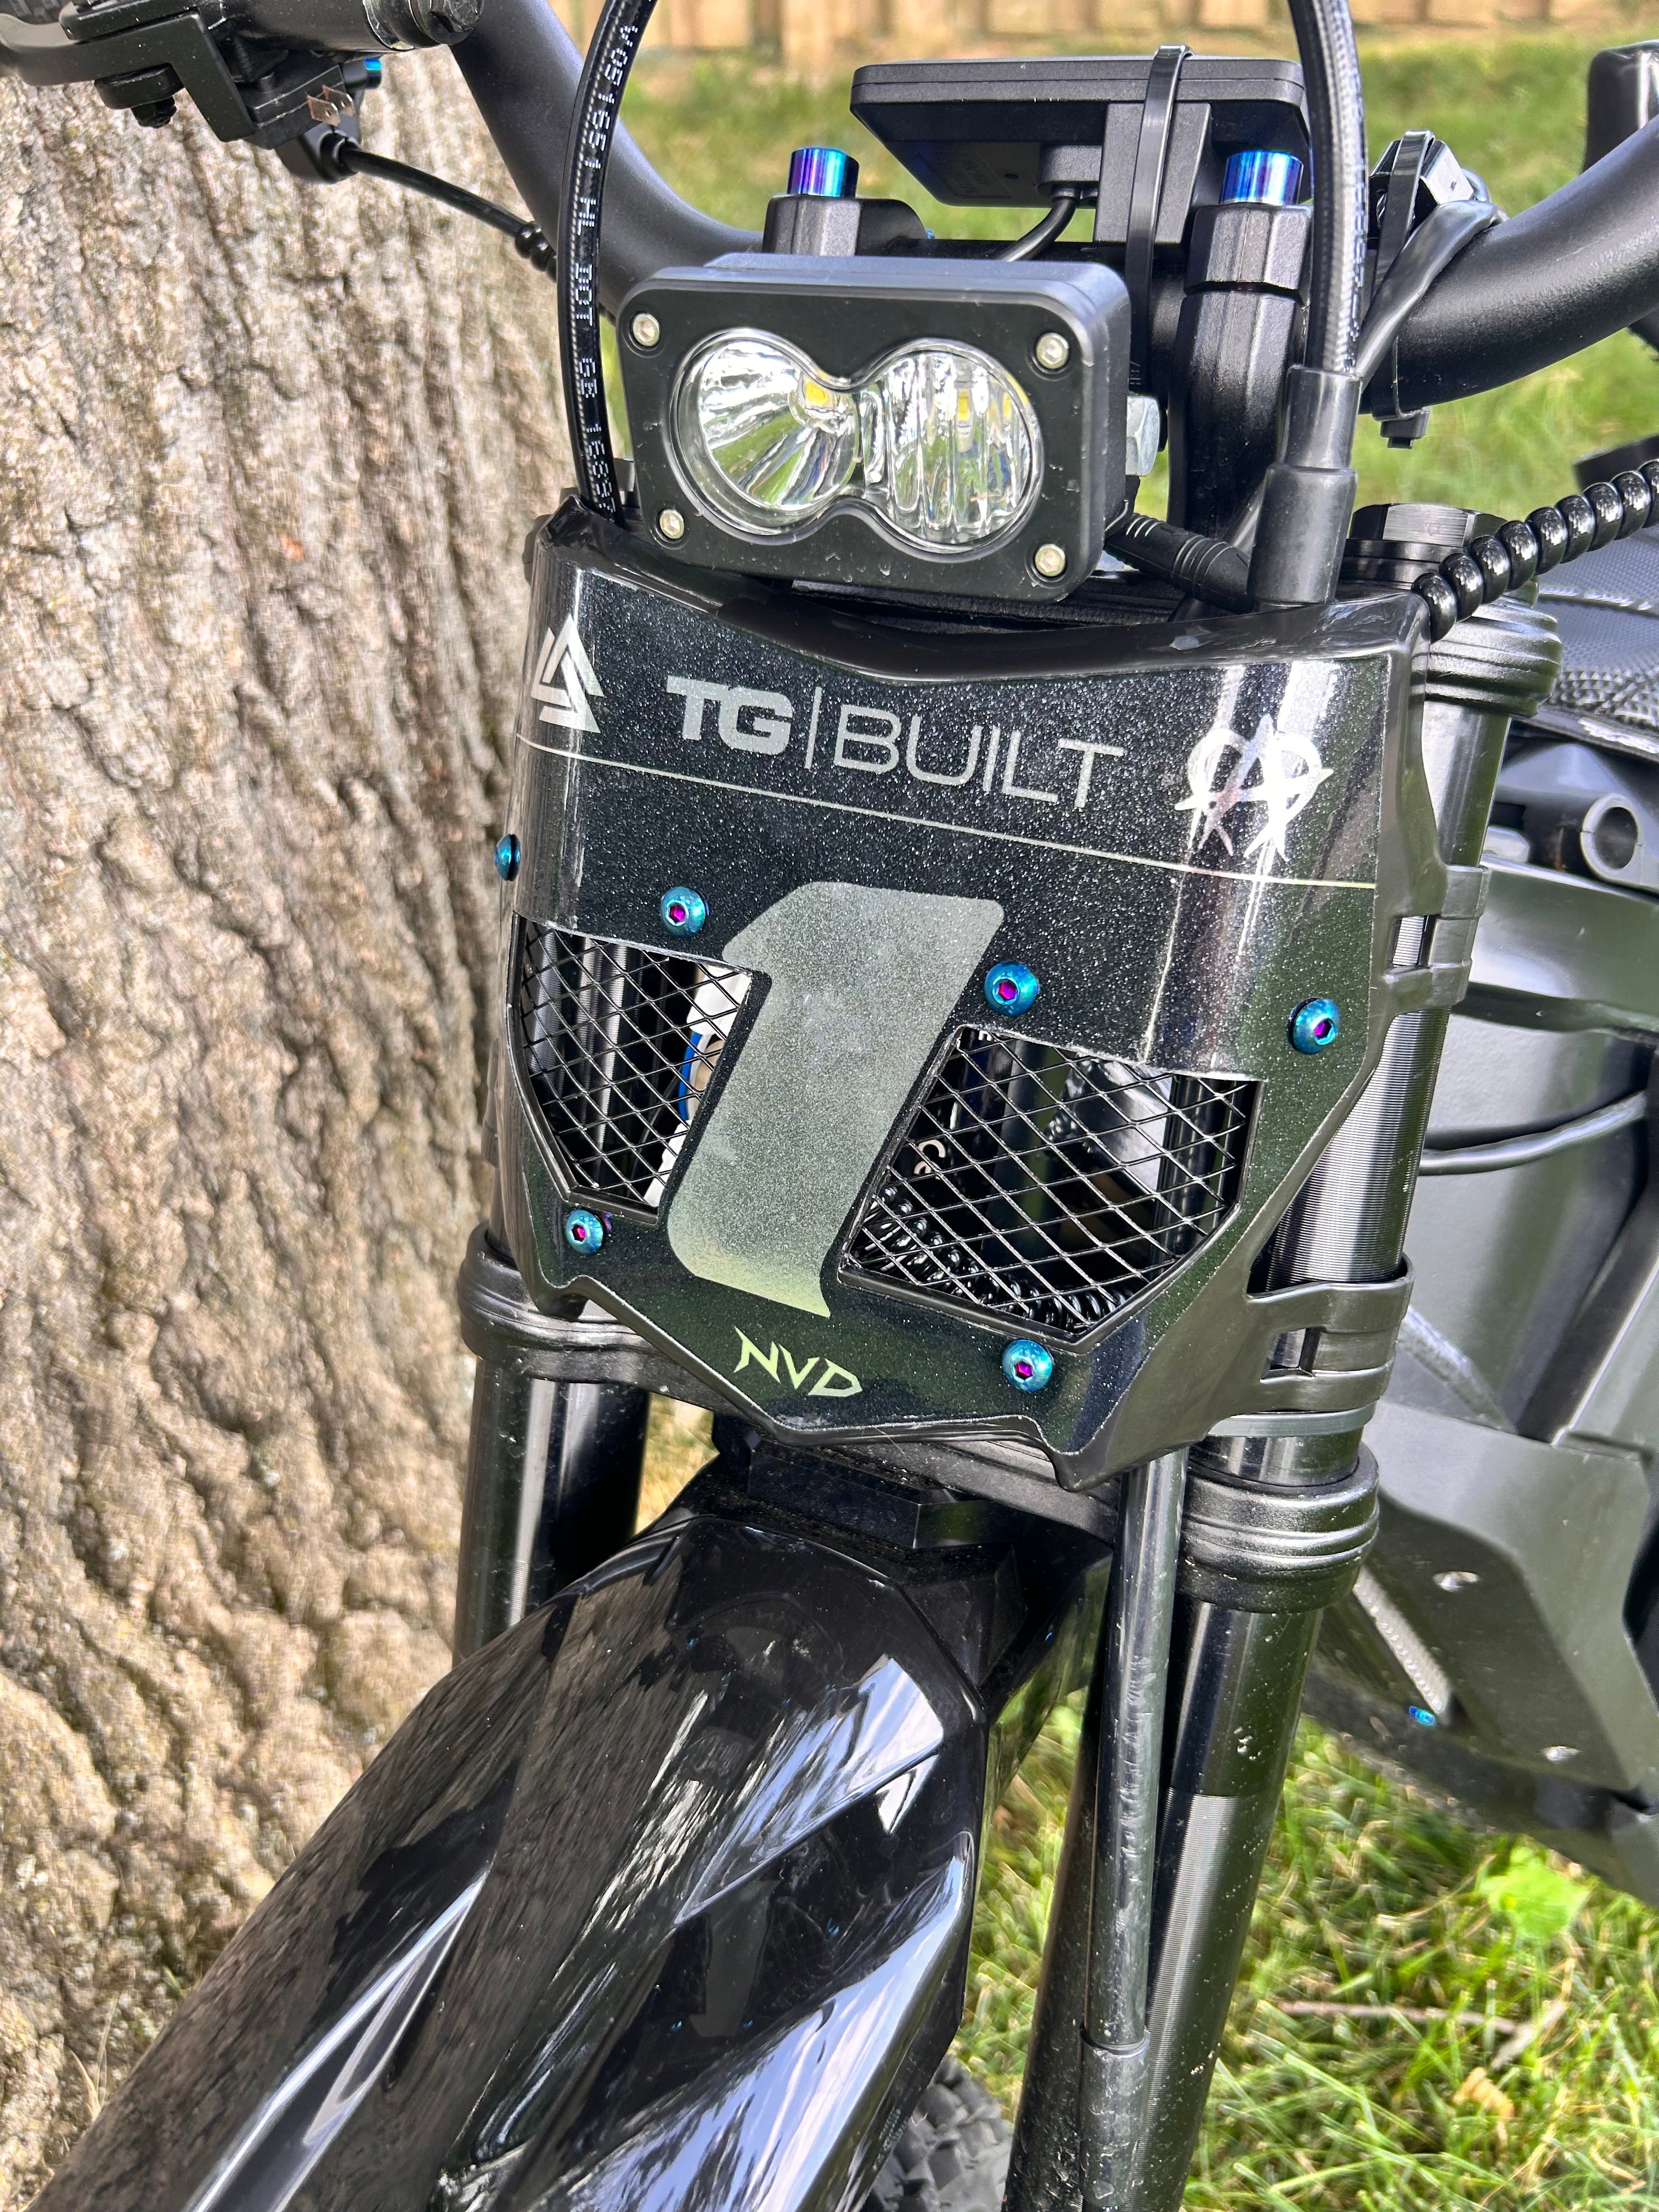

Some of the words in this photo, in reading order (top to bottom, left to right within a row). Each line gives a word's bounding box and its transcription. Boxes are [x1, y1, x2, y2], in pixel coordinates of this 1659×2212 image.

[577, 196, 596, 236] HL
[575, 262, 593, 326] DOT
[579, 358, 597, 398] GB
[665, 675, 793, 756] TG
[832, 704, 1125, 810] BUILT
[668, 881, 1005, 1318] 1
[733, 1325, 863, 1398] NVD
